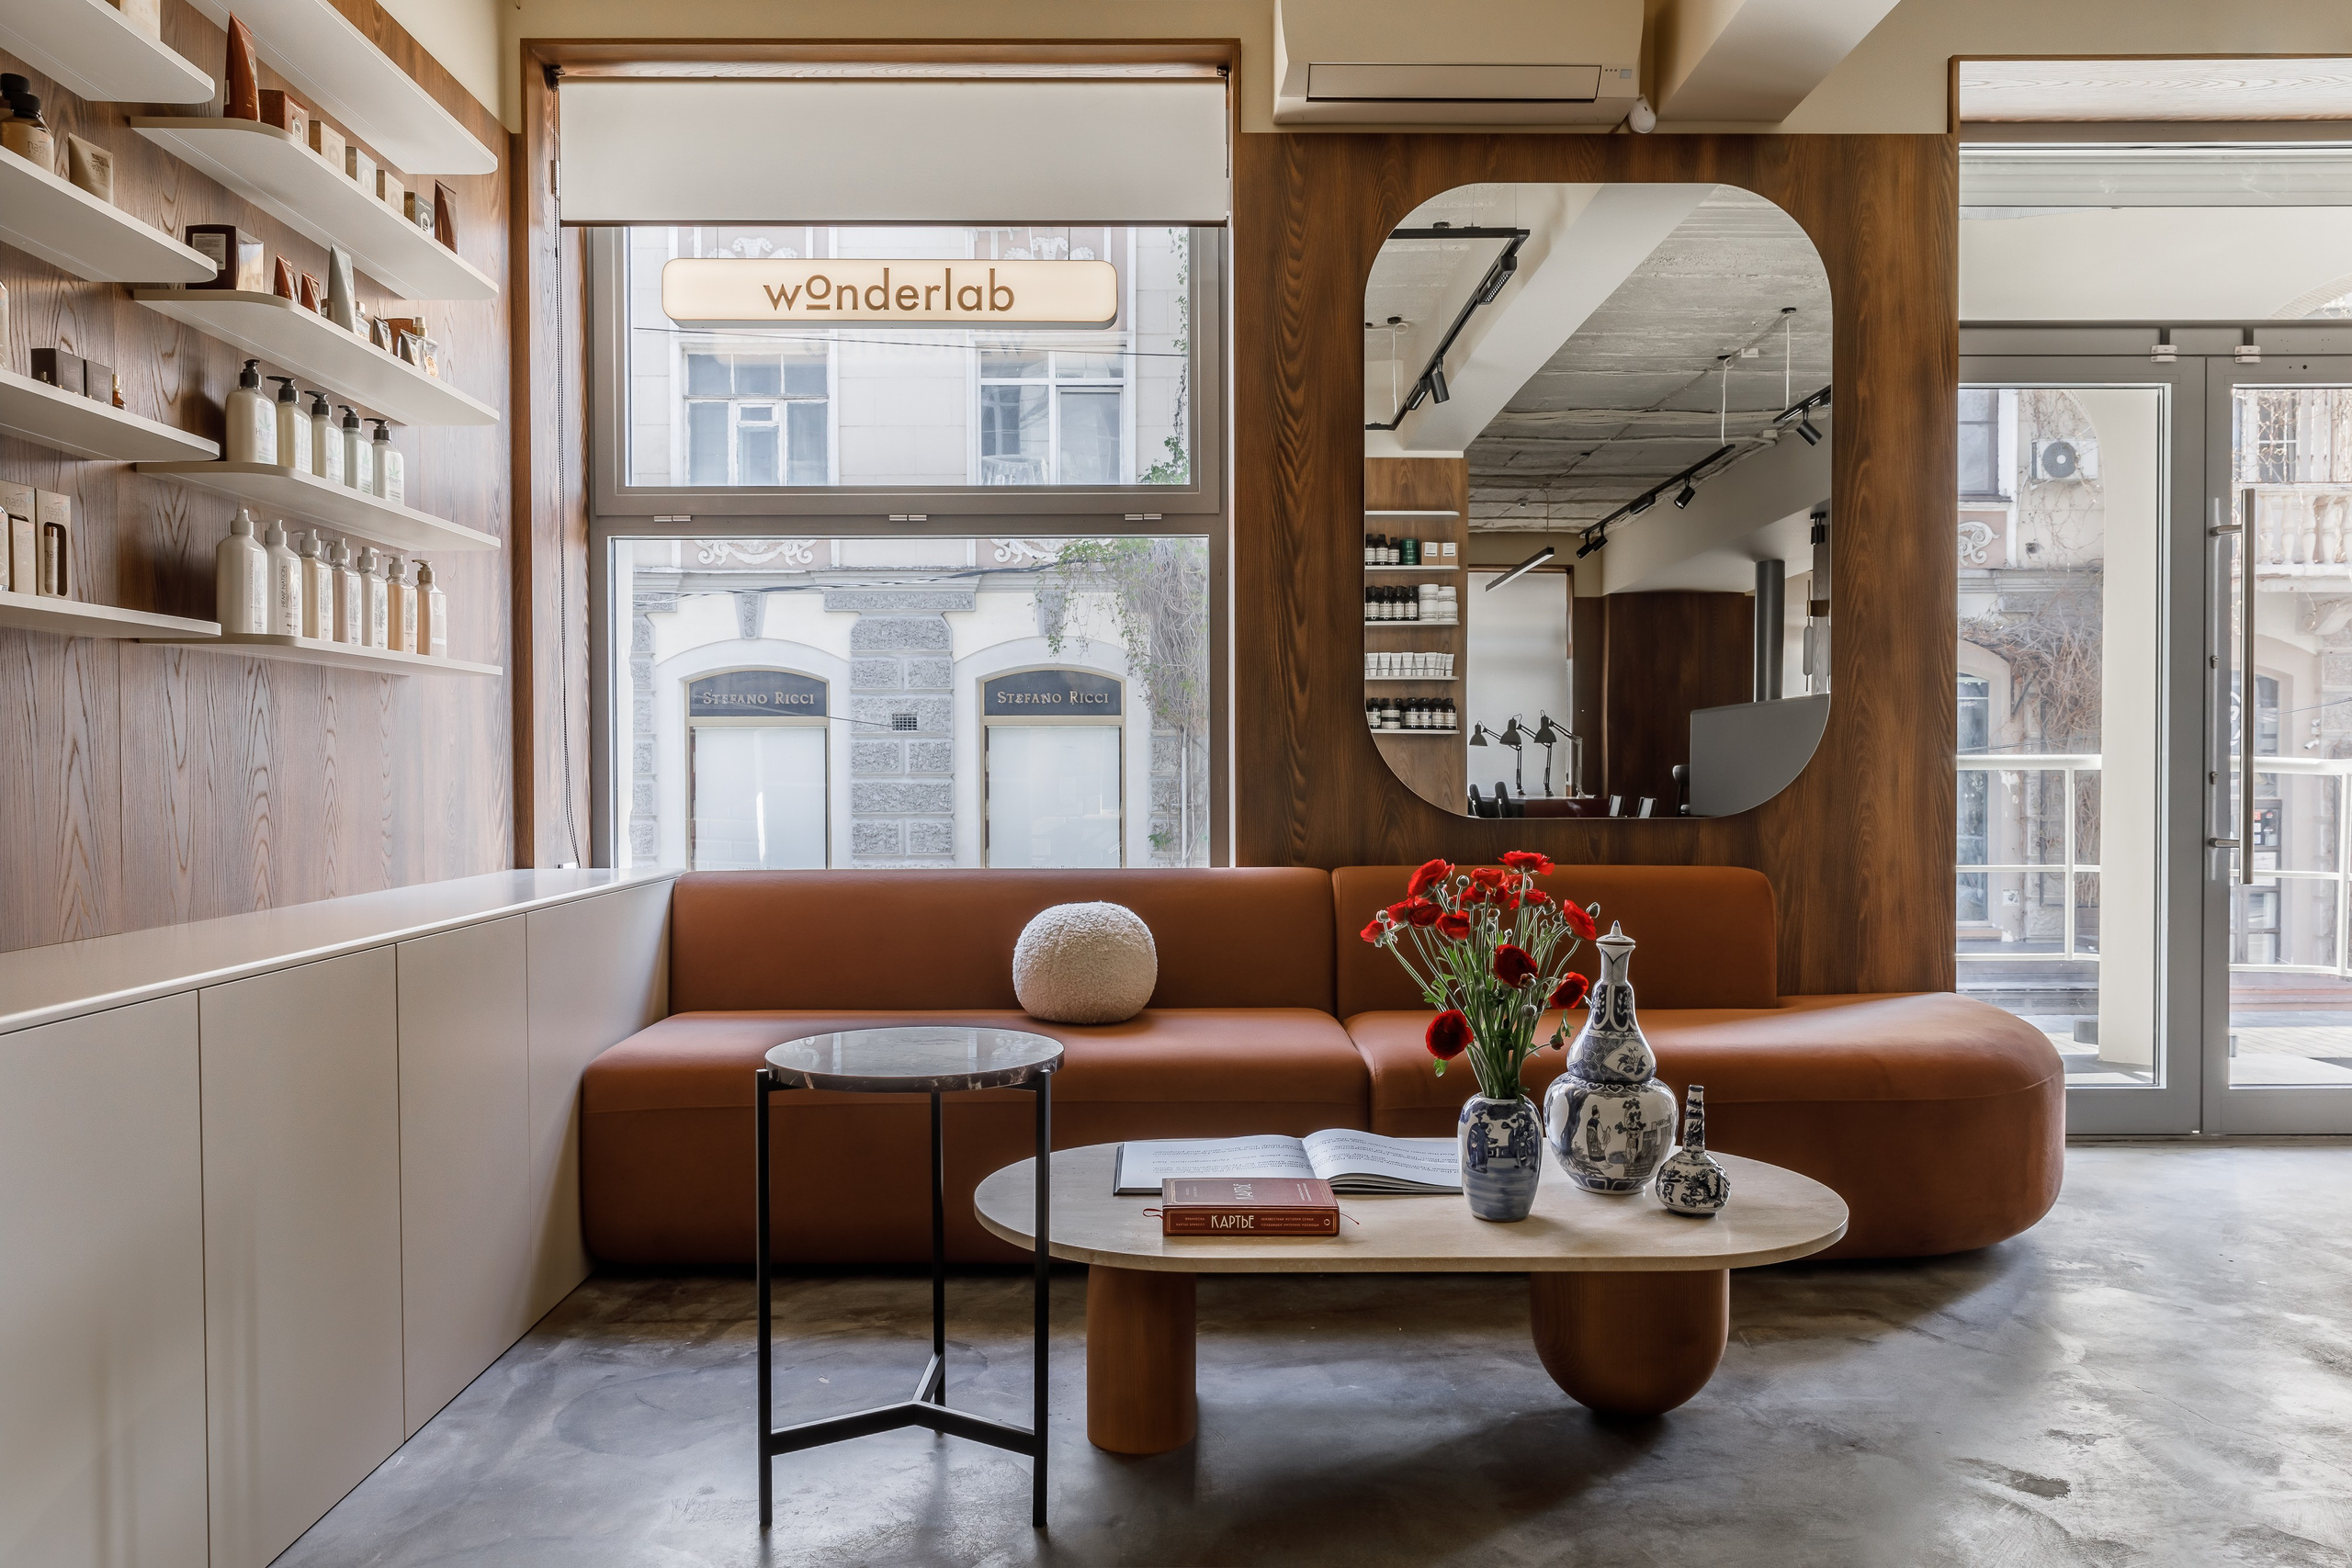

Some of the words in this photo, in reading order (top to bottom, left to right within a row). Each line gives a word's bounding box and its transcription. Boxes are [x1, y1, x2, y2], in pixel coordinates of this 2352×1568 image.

[763, 267, 1015, 311] wonderlab
[703, 692, 768, 705] STEFANO
[775, 692, 815, 705] RICCI
[997, 691, 1062, 704] STEFANO
[1069, 691, 1109, 704] RICCI
[1211, 1214, 1255, 1229] КАРТЬЕ
